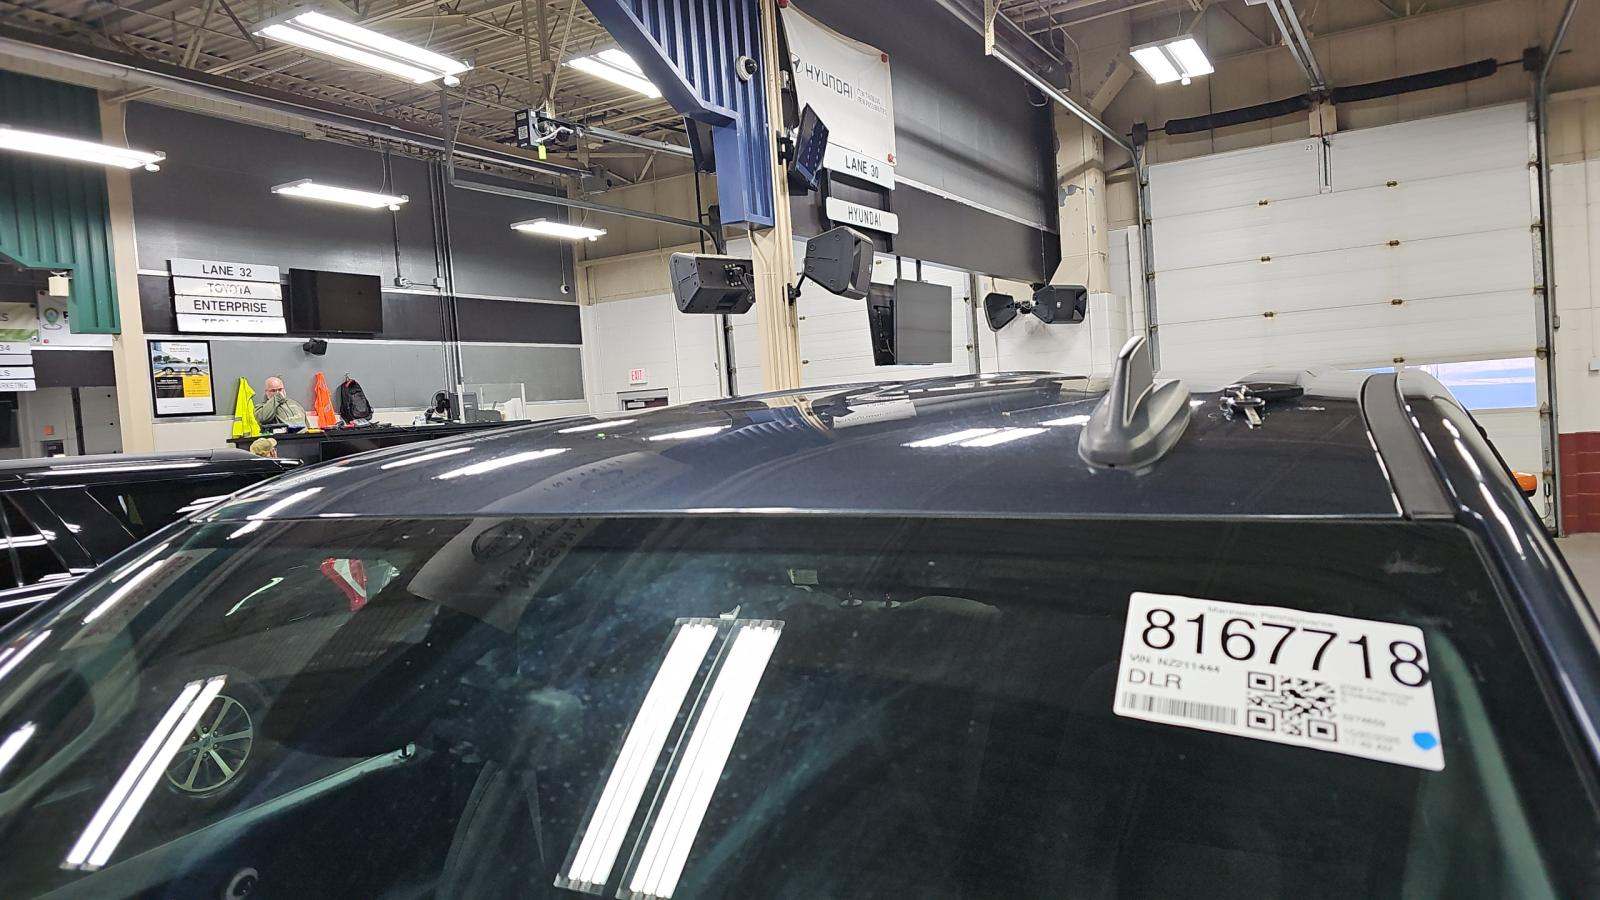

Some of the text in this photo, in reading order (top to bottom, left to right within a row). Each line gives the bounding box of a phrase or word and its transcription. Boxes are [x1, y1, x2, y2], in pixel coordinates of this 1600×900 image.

[805, 63, 853, 99] HYUNDAI
[845, 156, 879, 179] LANE 30
[848, 206, 881, 227] HYUNDAI
[202, 264, 252, 278] LANE 32
[193, 299, 268, 313] ENTERPRISE
[1142, 608, 1431, 688] 8167718
[1129, 668, 1182, 690] DLR
